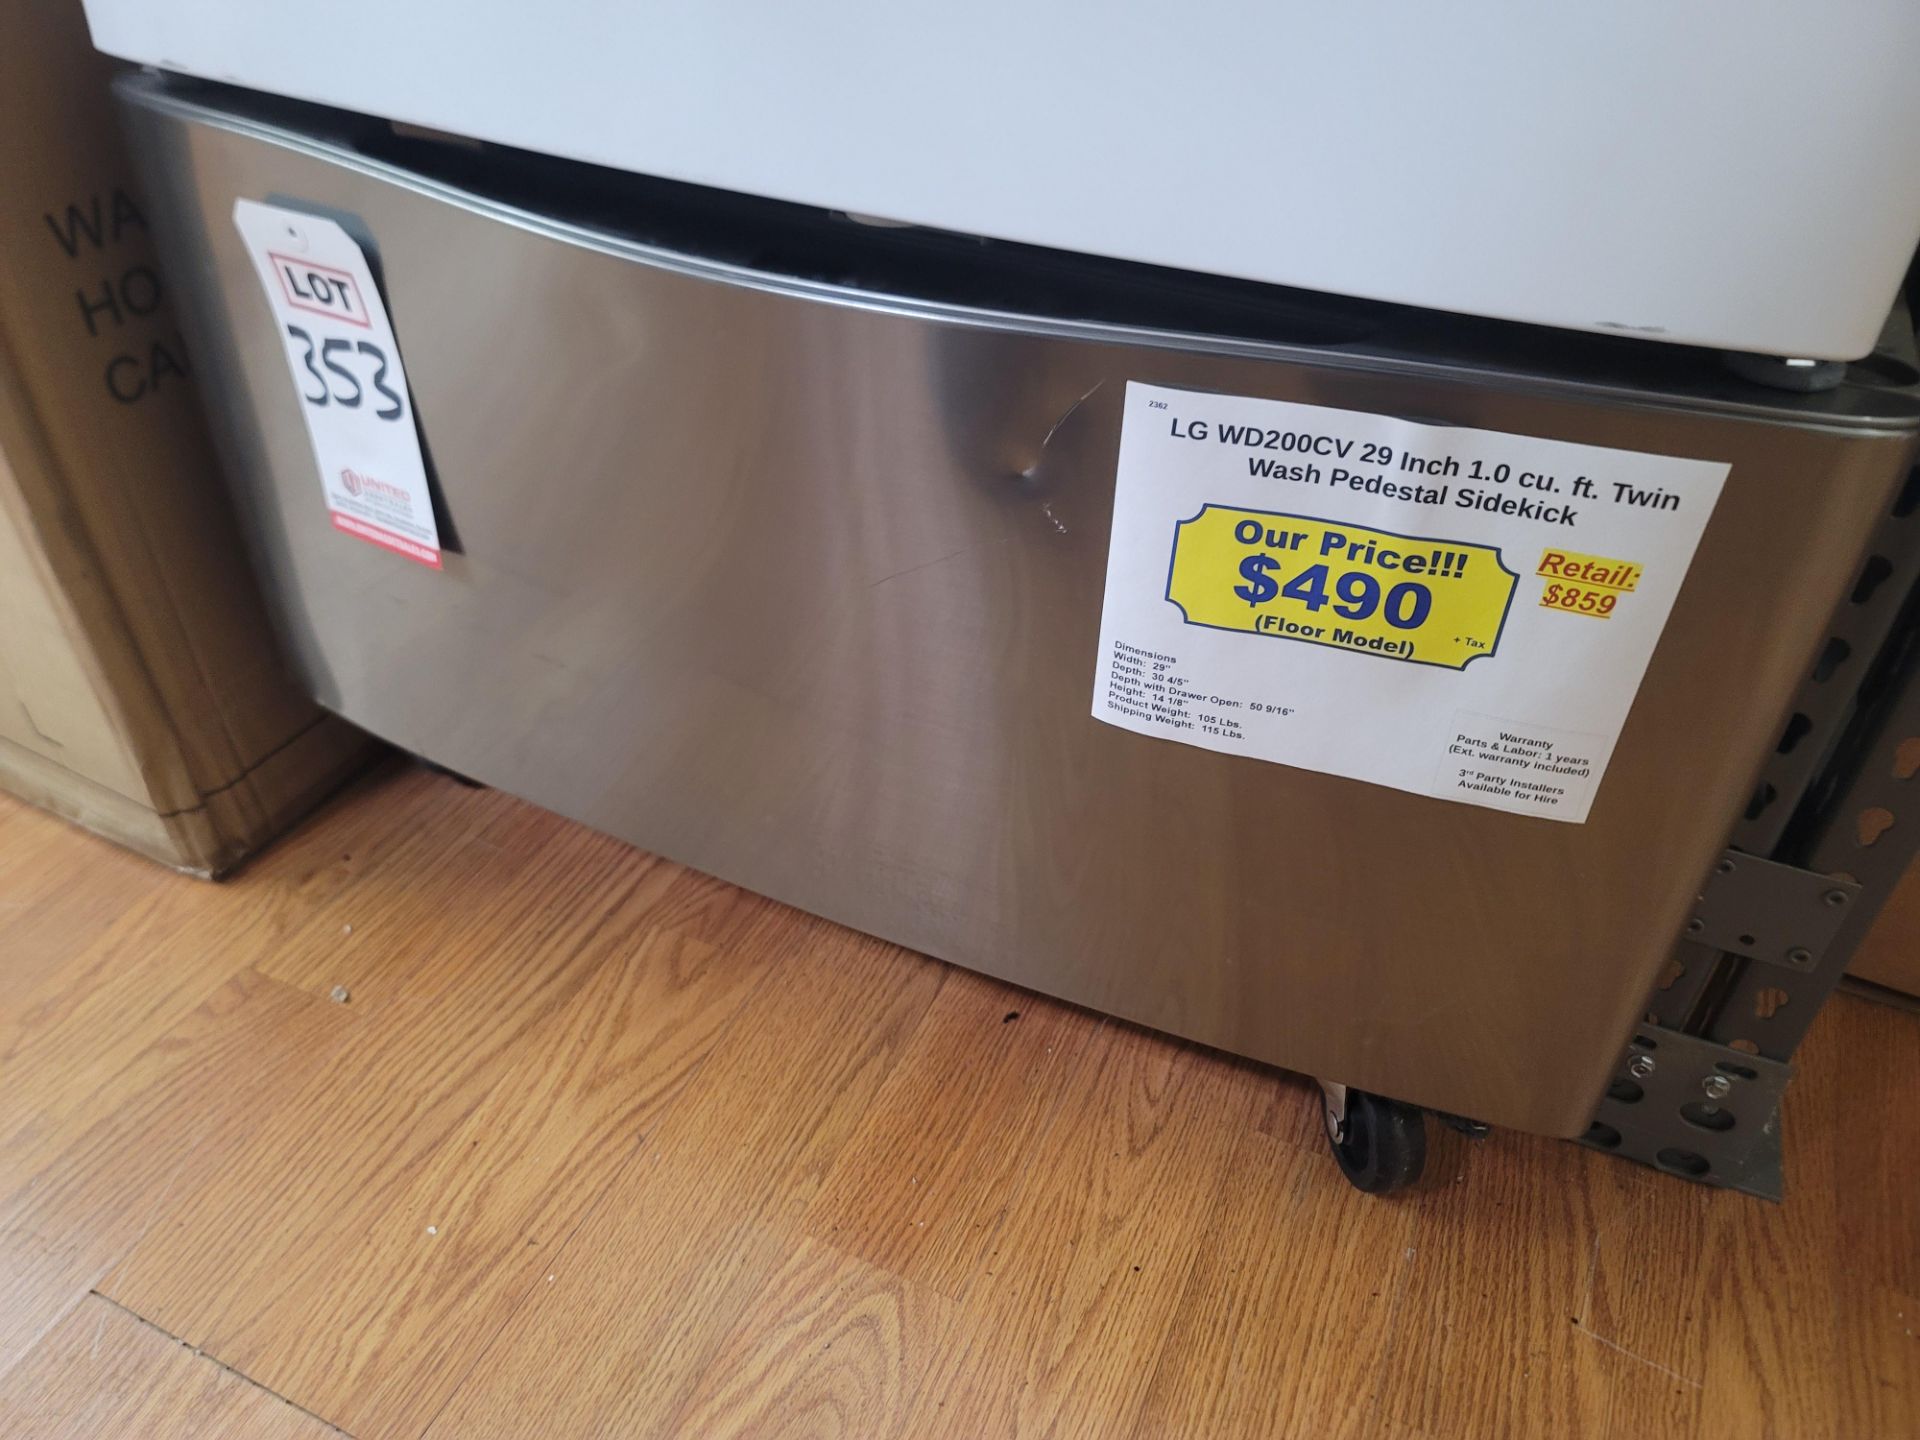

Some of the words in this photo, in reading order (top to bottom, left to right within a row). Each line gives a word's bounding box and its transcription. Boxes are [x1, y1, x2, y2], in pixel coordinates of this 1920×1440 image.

[76, 266, 162, 337] HO
[284, 265, 352, 312] LOT
[287, 323, 403, 421] 353
[1148, 400, 1168, 410] 2362
[1170, 417, 1209, 441] LG
[1217, 423, 1355, 458] WD200CV
[1359, 442, 1393, 466] 29
[1399, 451, 1460, 477] Inch
[1467, 460, 1511, 483] 1.0
[1518, 471, 1560, 493] cu.
[1571, 476, 1599, 499] ft.
[1612, 482, 1681, 511] Twin
[361, 471, 412, 502] UNITED
[1248, 457, 1322, 484] Wash
[1329, 467, 1449, 505] Pedestal
[1454, 488, 1579, 526] Sidekick
[1233, 519, 1309, 551] Our
[1319, 530, 1469, 579] Price!!!
[1537, 552, 1642, 589] Retail:
[1232, 552, 1433, 630] $490
[1541, 582, 1618, 616] $859
[1114, 640, 1177, 664] Dimensions
[1254, 613, 1326, 640] (Floor
[1331, 628, 1415, 660] Model)
[1465, 635, 1486, 649] Tax
[1112, 661, 1146, 678] Depth:
[1151, 672, 1165, 682] 30
[1113, 651, 1147, 668] Width:
[1153, 662, 1171, 672] 29"
[1109, 681, 1146, 699] Height:
[1152, 693, 1165, 703] 14
[1111, 671, 1141, 688] Depth
[1144, 681, 1166, 693] with
[1168, 687, 1208, 702] Drawer
[1210, 696, 1243, 709] Open:
[1249, 702, 1263, 712] 50
[1107, 700, 1152, 721] Shipping
[1155, 711, 1195, 730] Weight:
[1201, 725, 1220, 735] 115
[1222, 728, 1246, 740] Lbs.
[1108, 691, 1149, 709] Product
[1151, 700, 1191, 719] Weight:
[1198, 714, 1217, 725] 105
[1219, 718, 1243, 729] Lbs.
[1456, 734, 1488, 749] Parts
[1490, 742, 1500, 751] &
[1503, 745, 1542, 759] Labor:
[1545, 752, 1552, 761] 1
[1554, 754, 1590, 766] years
[1499, 732, 1554, 750] Warranty
[1448, 744, 1475, 758] (Ext.
[1478, 751, 1531, 769] warranty
[1533, 760, 1590, 779] included)
[1458, 779, 1512, 797] Available
[1514, 790, 1531, 802] for
[1533, 795, 1559, 805] Hire
[1476, 772, 1507, 786] Party
[1509, 779, 1565, 796] Installers
